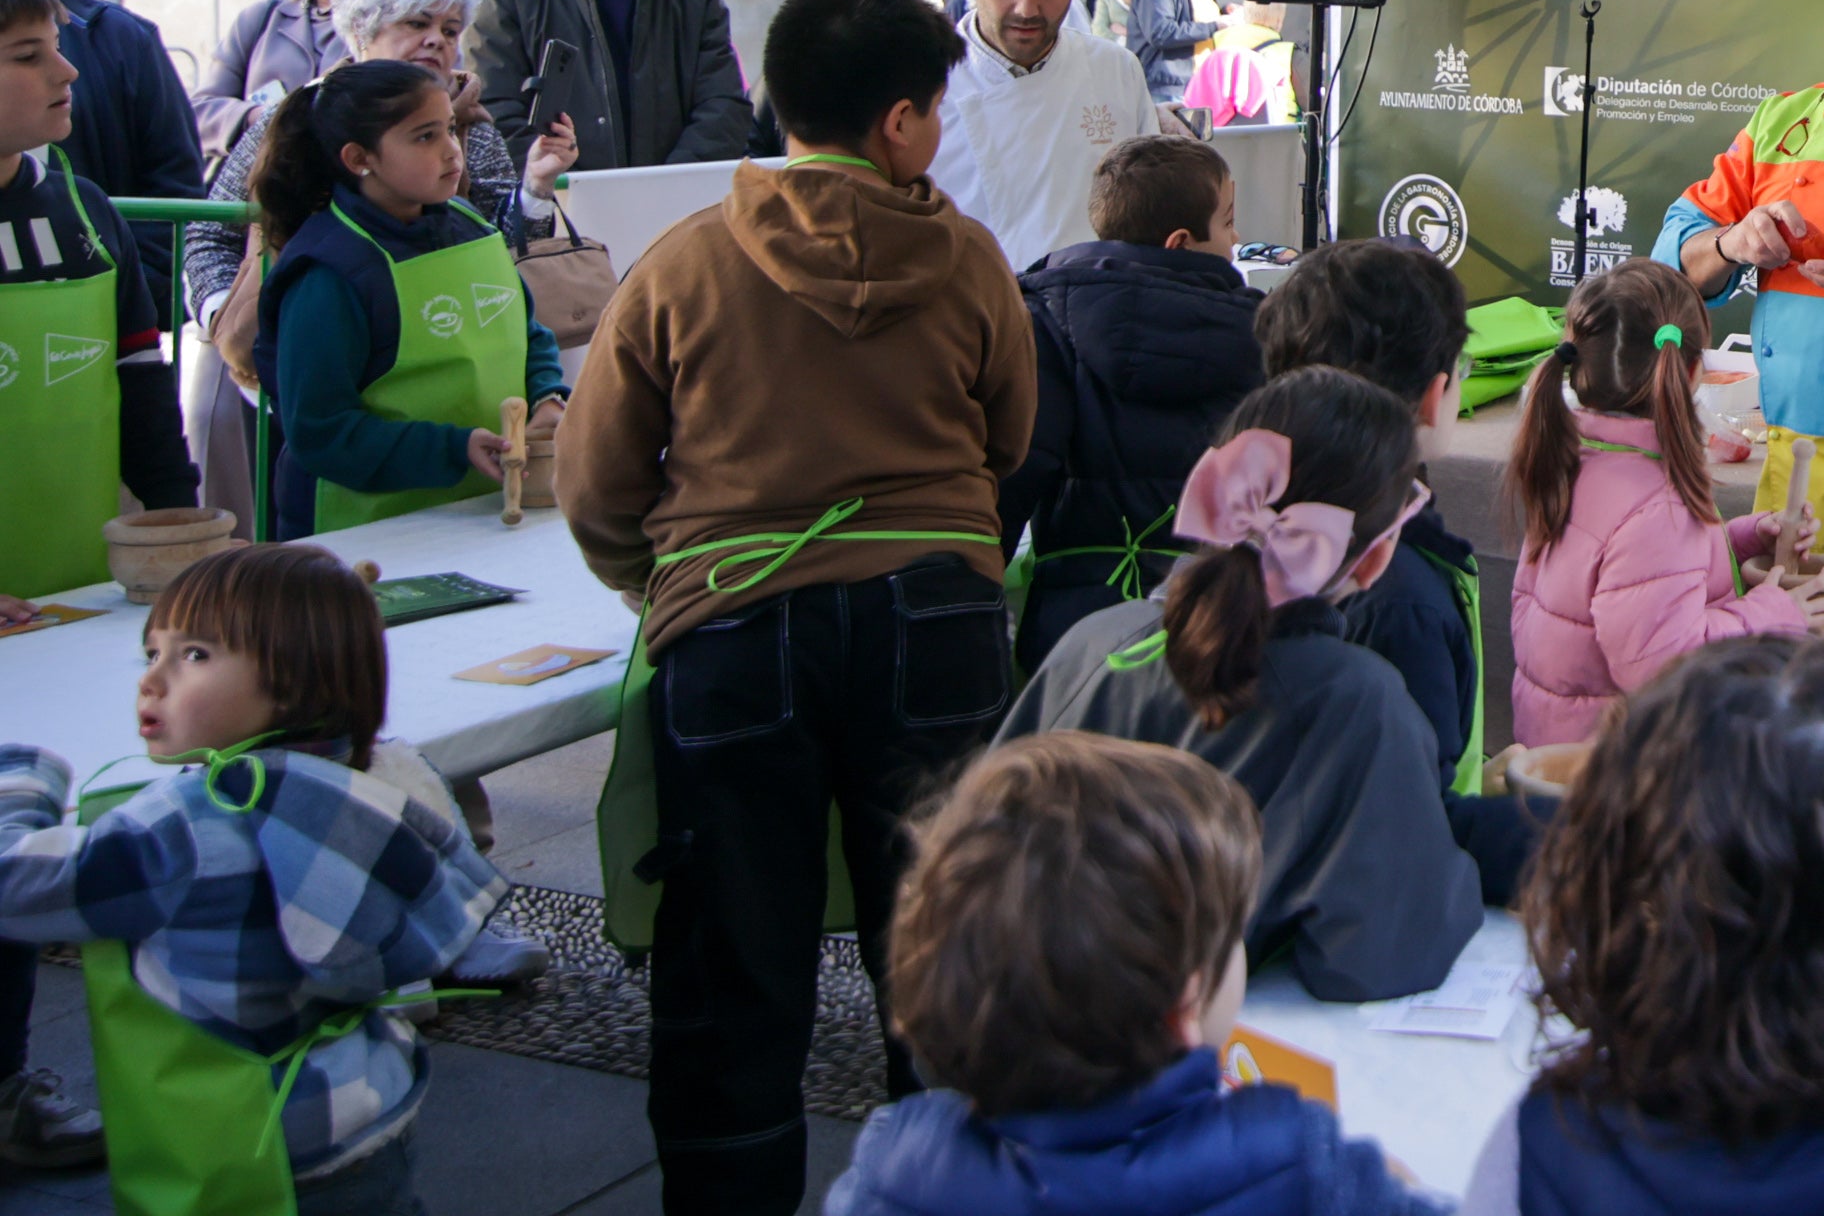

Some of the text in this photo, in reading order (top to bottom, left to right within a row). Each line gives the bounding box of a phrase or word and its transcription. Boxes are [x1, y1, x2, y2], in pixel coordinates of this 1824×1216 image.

[1597, 76, 1777, 100] Diputación de Córdoba
[1379, 90, 1524, 114] AYUNTAMIENTO DE CÓRDOBA
[1597, 95, 1651, 109] Delegación
[1653, 97, 1666, 109] de
[1669, 98, 1717, 112] Desarrollo
[1596, 109, 1646, 122] Promoción
[1656, 112, 1695, 125] Empleo
[1391, 202, 1400, 215] DE
[1406, 184, 1458, 219] GASTRONOMÍA
[1436, 221, 1459, 261] CORDOBE
[1600, 240, 1608, 249] de
[1609, 241, 1632, 251] Origen
